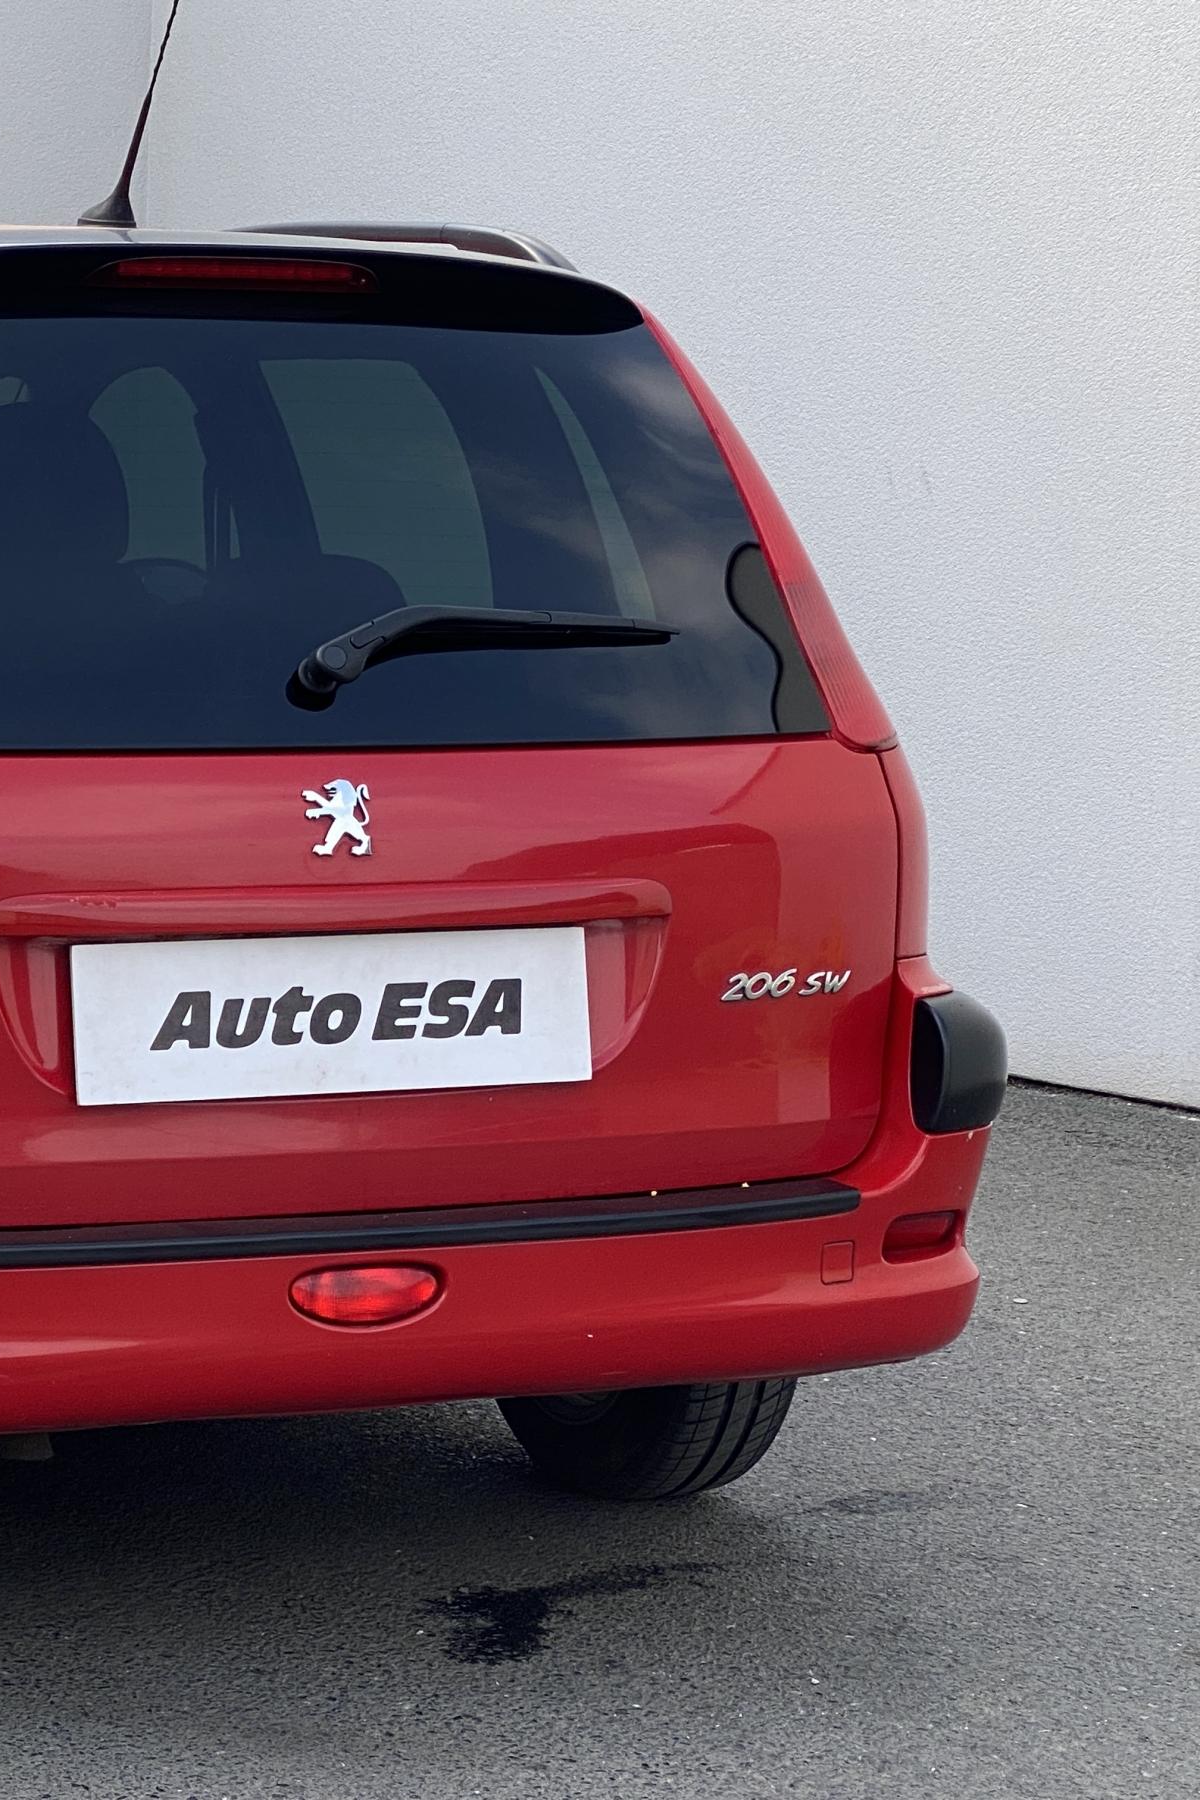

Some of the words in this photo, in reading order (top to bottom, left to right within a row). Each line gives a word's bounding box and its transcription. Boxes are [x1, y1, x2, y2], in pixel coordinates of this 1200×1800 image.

[720, 968, 798, 1002] 206
[798, 969, 852, 997] SW
[149, 986, 362, 1051] Auto
[371, 978, 522, 1041] ESA
